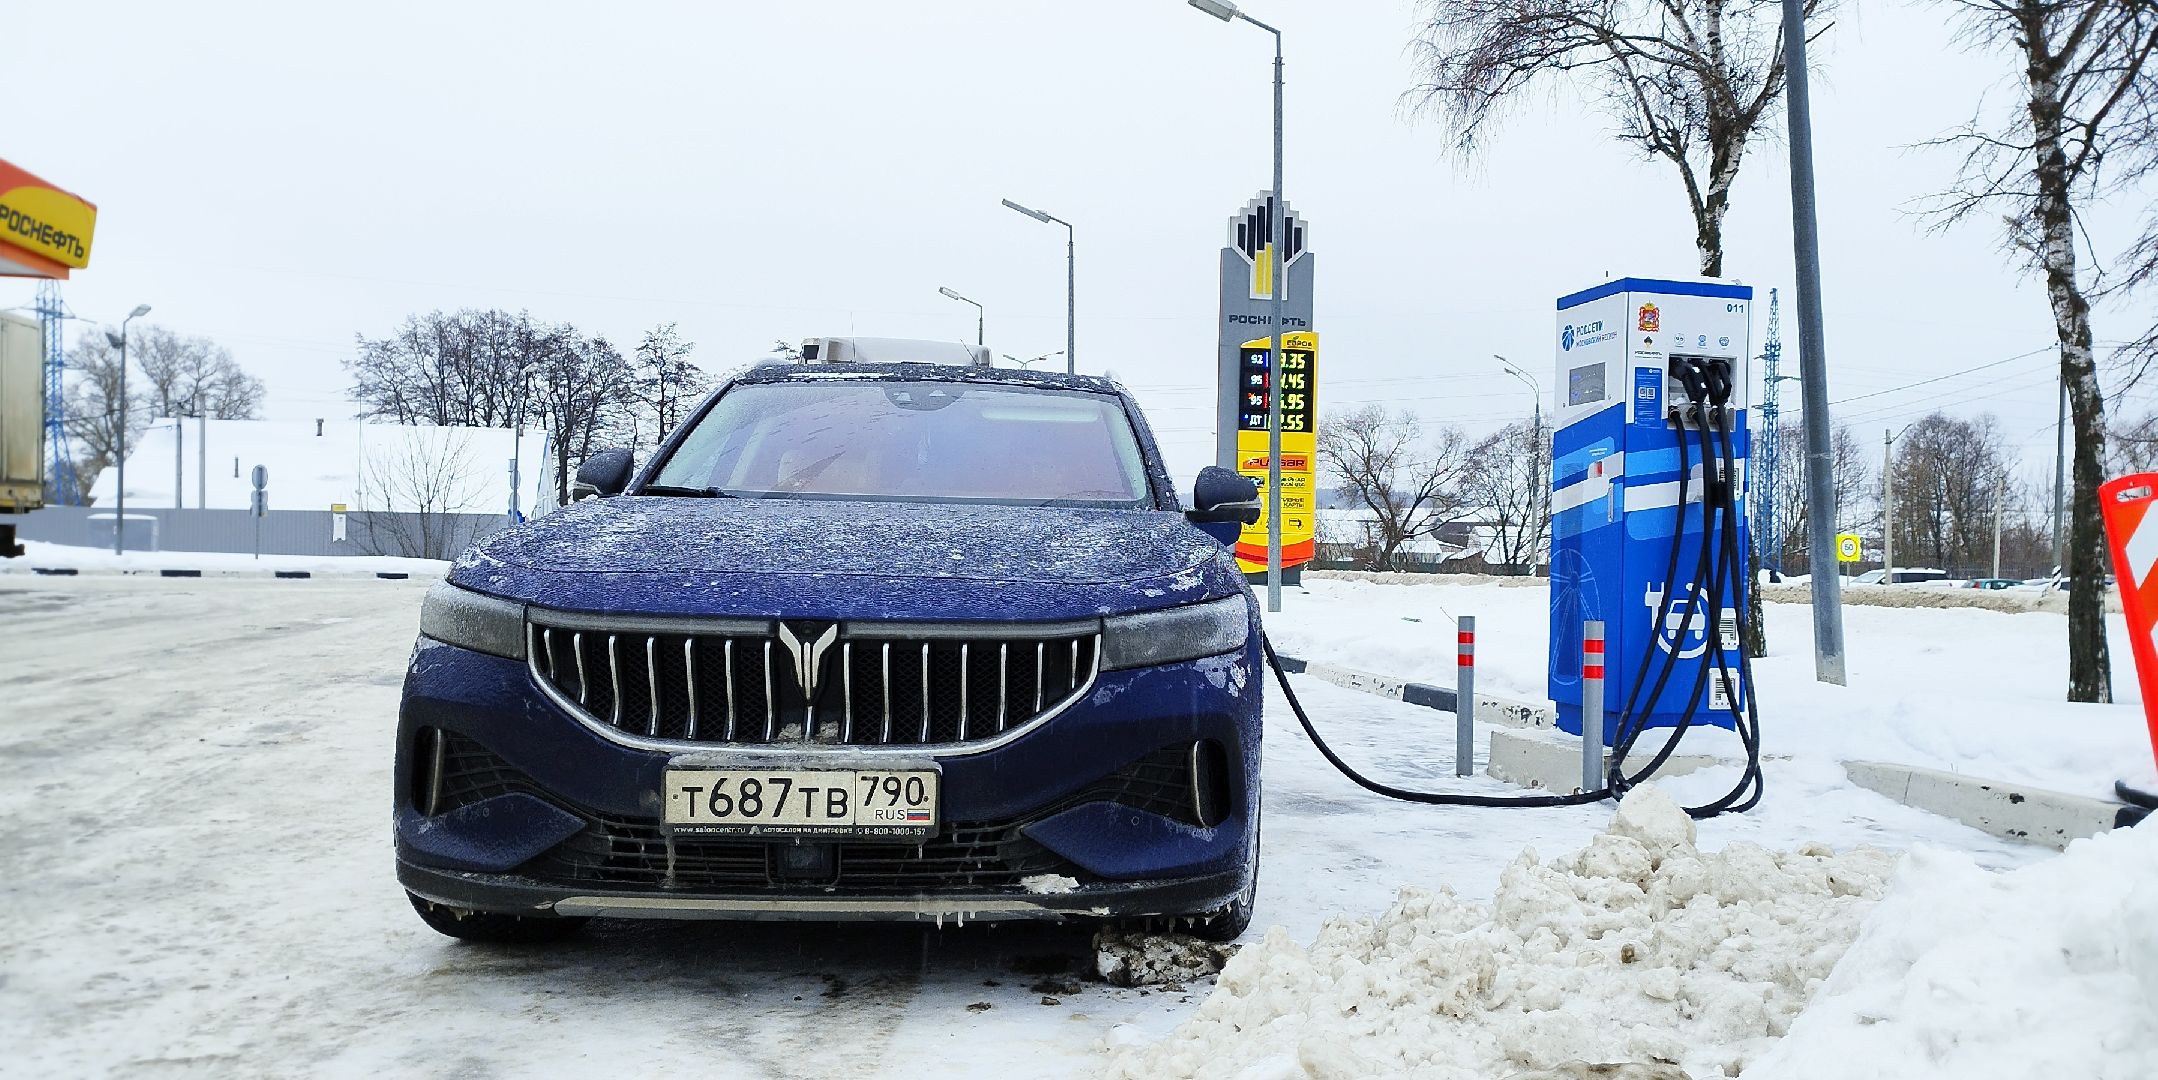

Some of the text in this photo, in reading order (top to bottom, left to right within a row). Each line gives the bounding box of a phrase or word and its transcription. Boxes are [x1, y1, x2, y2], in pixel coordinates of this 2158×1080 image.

[0, 204, 84, 258] РОСНЕФТЬ
[1727, 303, 1743, 314] 011
[1250, 353, 1263, 365] 92
[1250, 374, 1263, 385] 95
[1250, 395, 1263, 405] 95
[1249, 414, 1262, 426] ДТ
[681, 775, 926, 818] Т687ТВ 790
[875, 809, 906, 820] RUS
